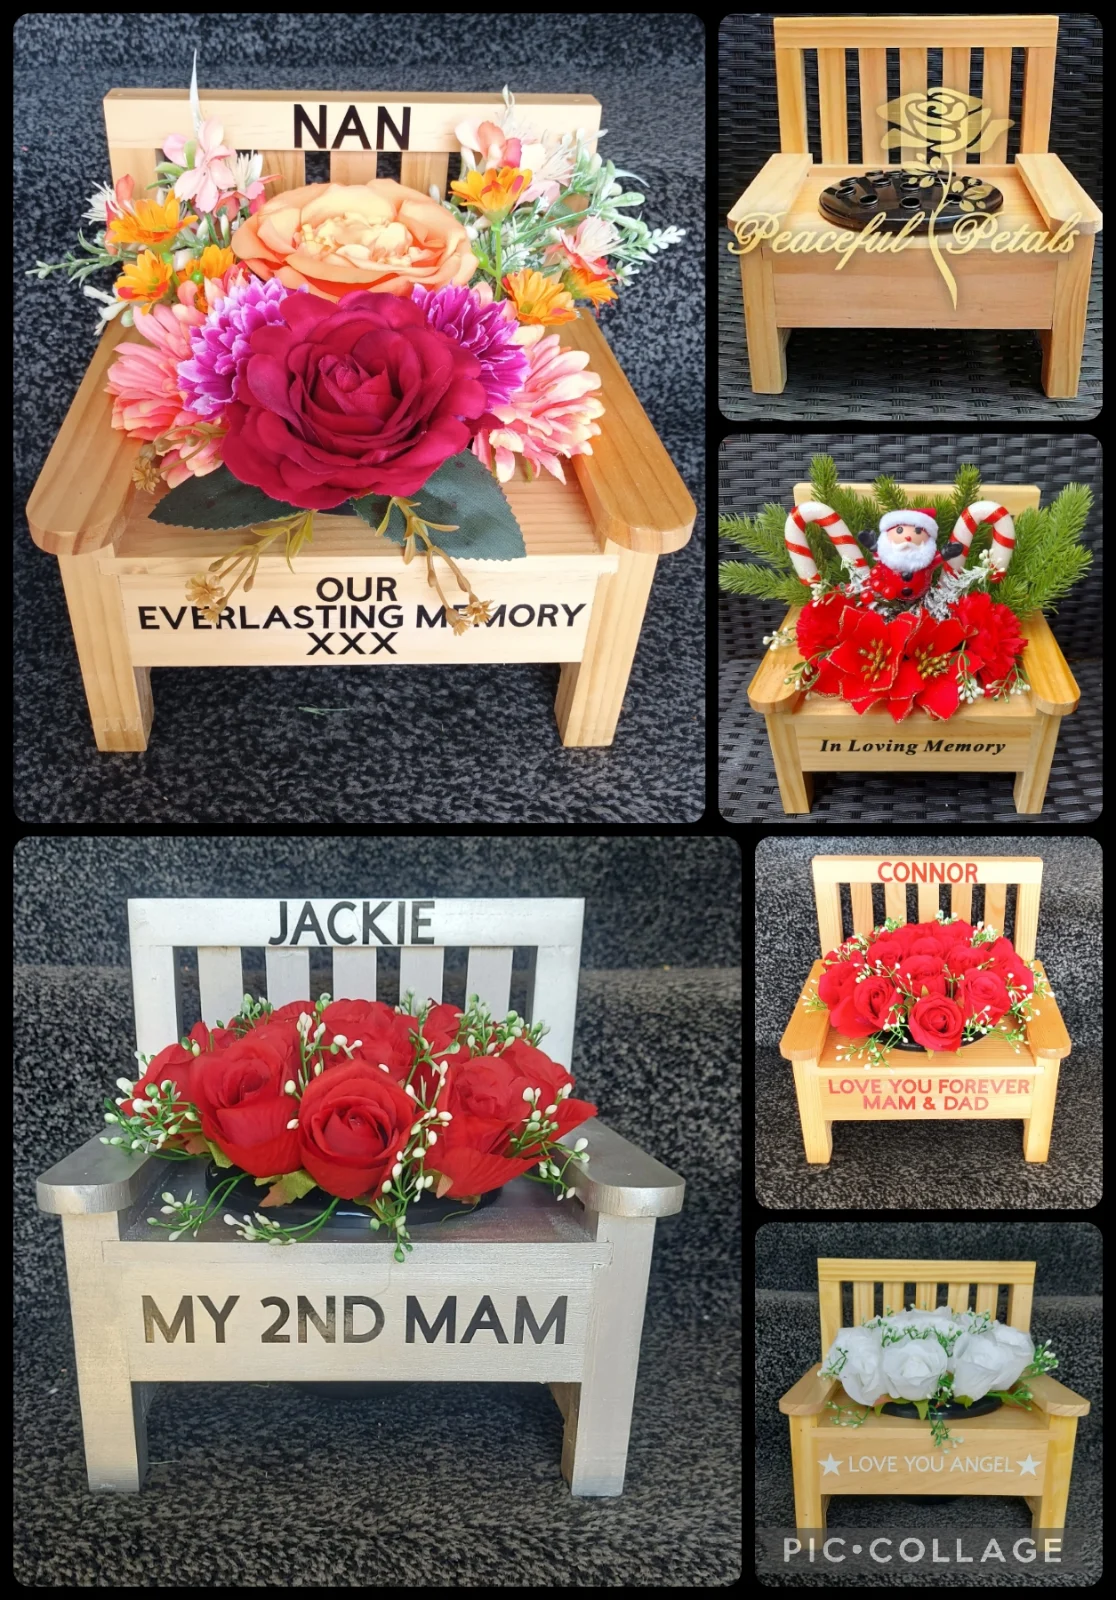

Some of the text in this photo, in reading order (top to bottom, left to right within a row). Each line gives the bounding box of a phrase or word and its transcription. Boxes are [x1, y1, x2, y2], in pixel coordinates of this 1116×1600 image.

[293, 103, 412, 151] NAN
[315, 576, 398, 602] OUR
[137, 604, 405, 630] EVERLASTING
[305, 632, 399, 656] XXX
[819, 739, 1007, 756] In Loving Memory
[877, 861, 978, 883] CONNOR
[267, 900, 436, 946] JACKIE
[828, 1079, 1030, 1094] LOVE YOU FOREVER
[862, 1095, 990, 1111] MAM & DAD
[140, 1294, 569, 1345] MY 2ND MAM
[848, 1455, 1015, 1473] LOVE YOU ANGEL
